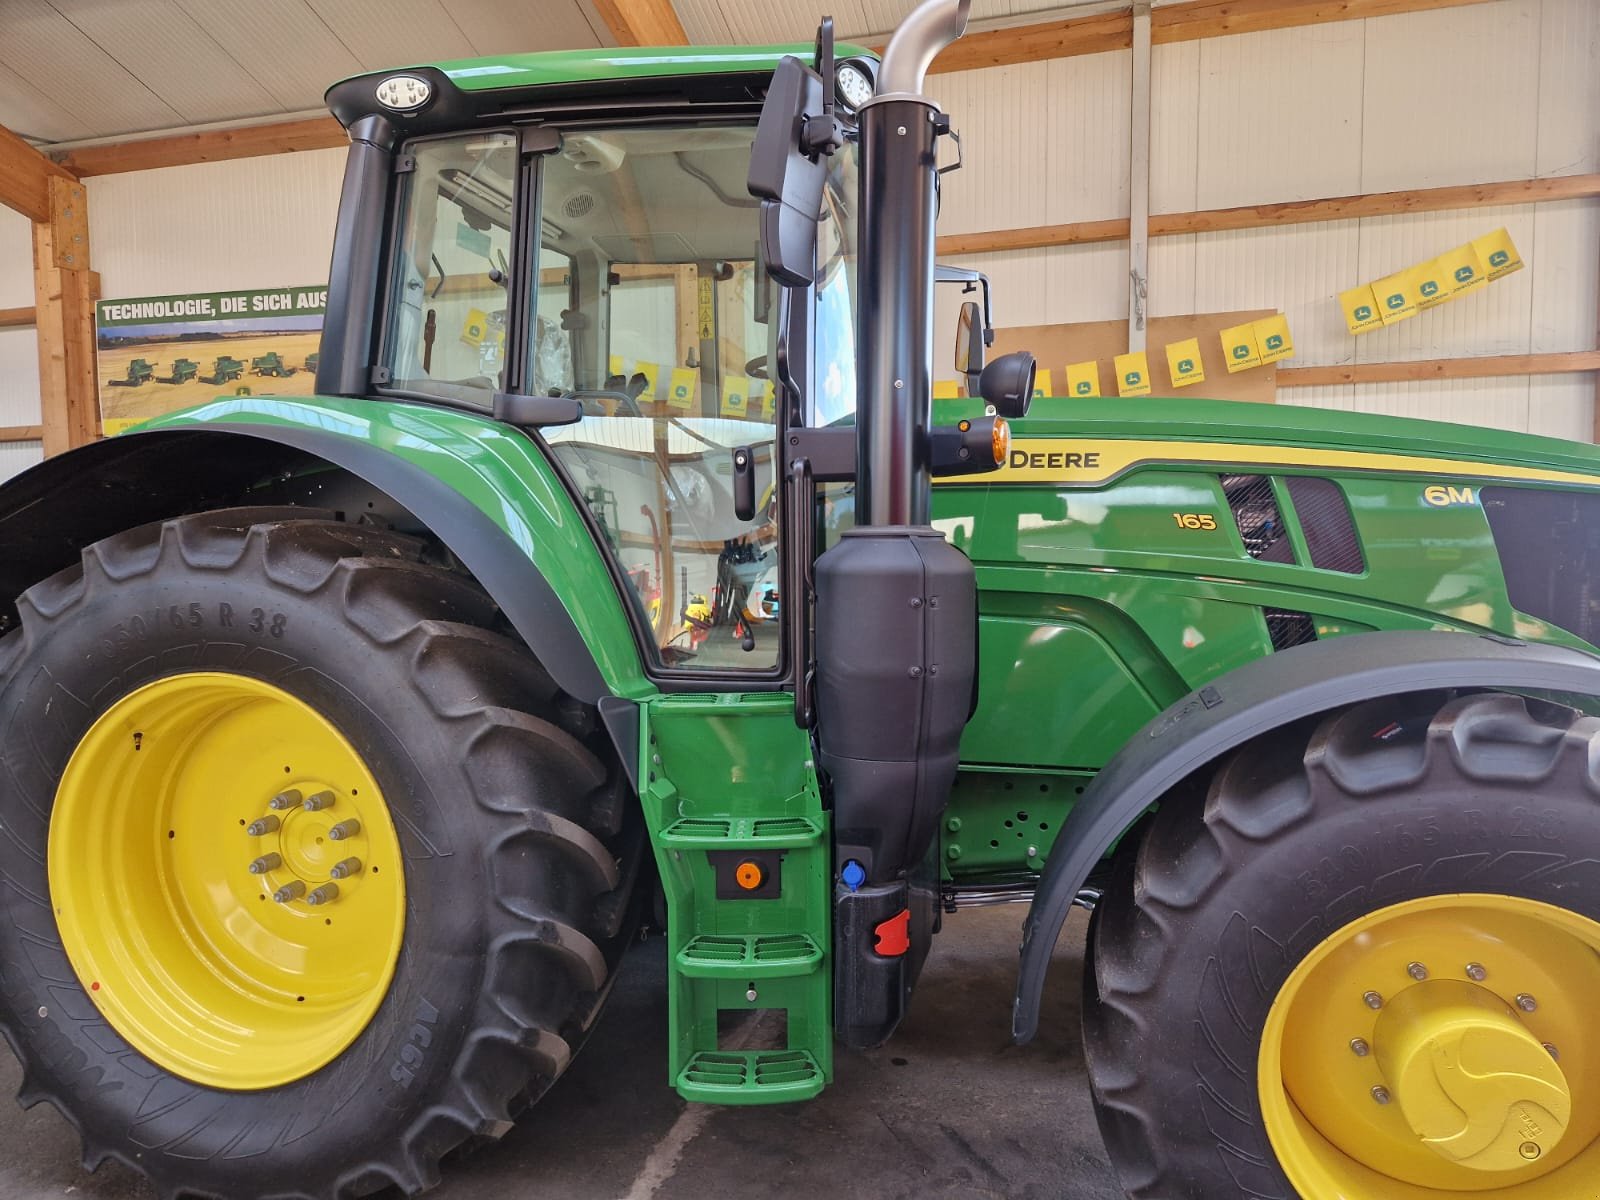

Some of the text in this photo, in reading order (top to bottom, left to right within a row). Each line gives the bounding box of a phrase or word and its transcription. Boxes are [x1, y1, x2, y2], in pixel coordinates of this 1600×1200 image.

[102, 299, 216, 320] TECHNOLOGIE,
[220, 296, 248, 314] DIE
[252, 293, 292, 311] SICH
[1009, 450, 1100, 469] DEERE
[1423, 485, 1475, 506] 6M
[1173, 512, 1218, 531] 165
[218, 602, 234, 628] R
[249, 607, 288, 639] 38
